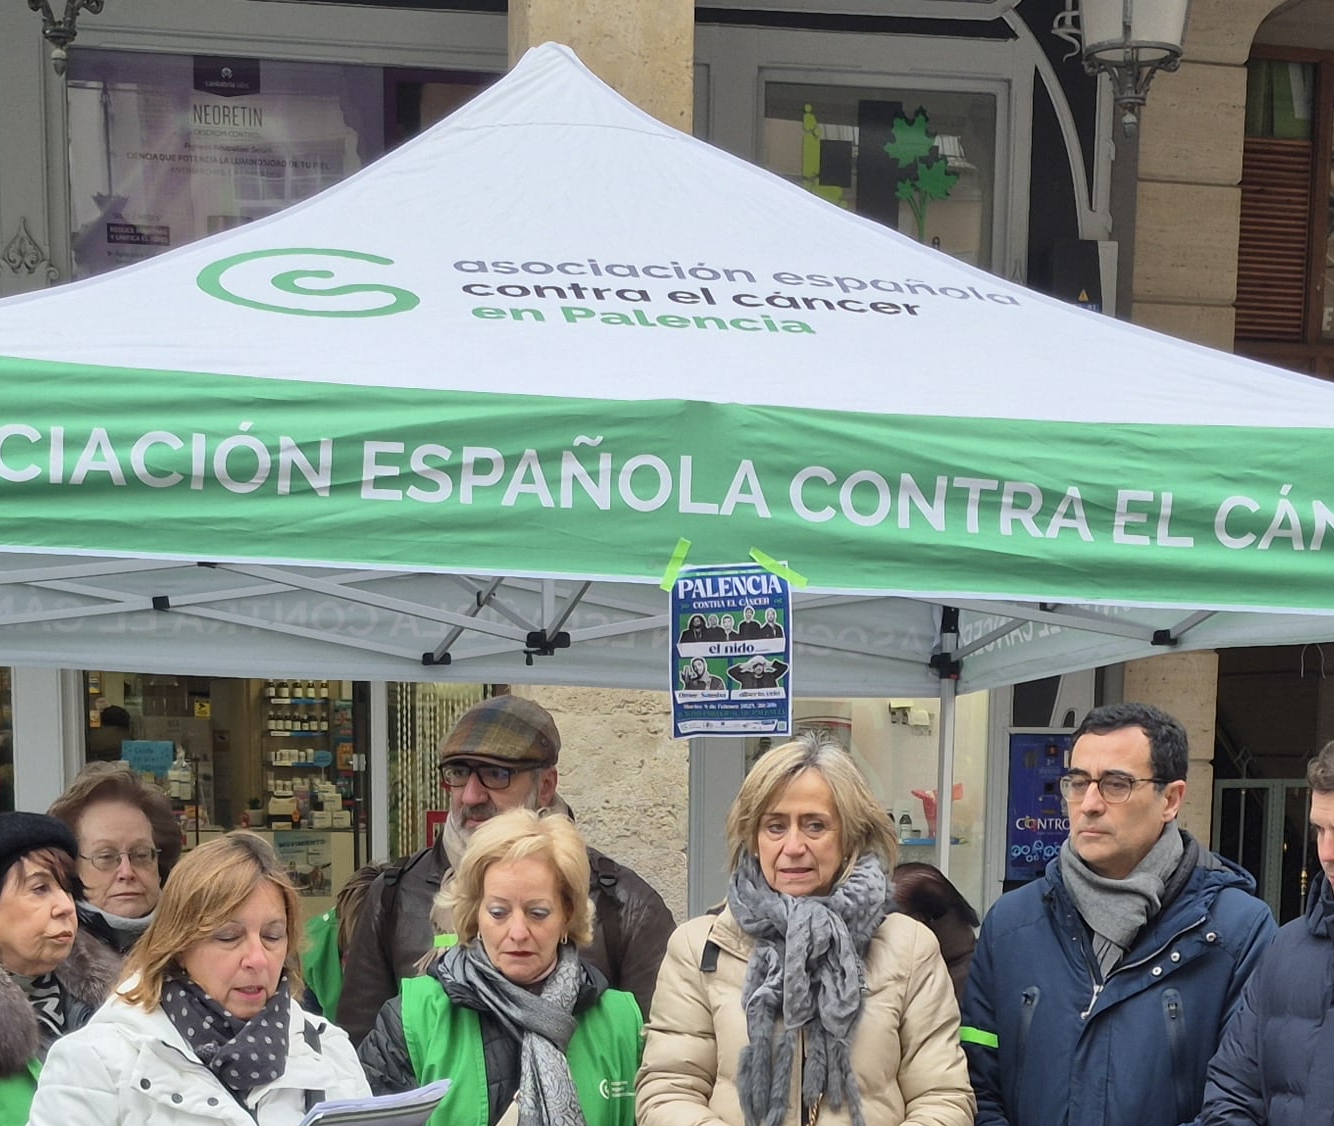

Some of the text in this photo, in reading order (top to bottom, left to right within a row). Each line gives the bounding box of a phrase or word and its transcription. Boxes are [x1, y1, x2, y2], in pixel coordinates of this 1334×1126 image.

[193, 103, 263, 127] NEORETIN
[453, 258, 1022, 307] asociación española
[462, 283, 921, 316] contra el cáncer
[471, 306, 816, 334] en Palencia
[360, 435, 771, 519] ESPAÑOLA
[789, 465, 1094, 542] CONTRA
[1113, 489, 1194, 549] EL
[677, 574, 783, 600] PALENCIA
[692, 596, 770, 610] CONTRA EL CÁNCER
[708, 642, 755, 654] el nido
